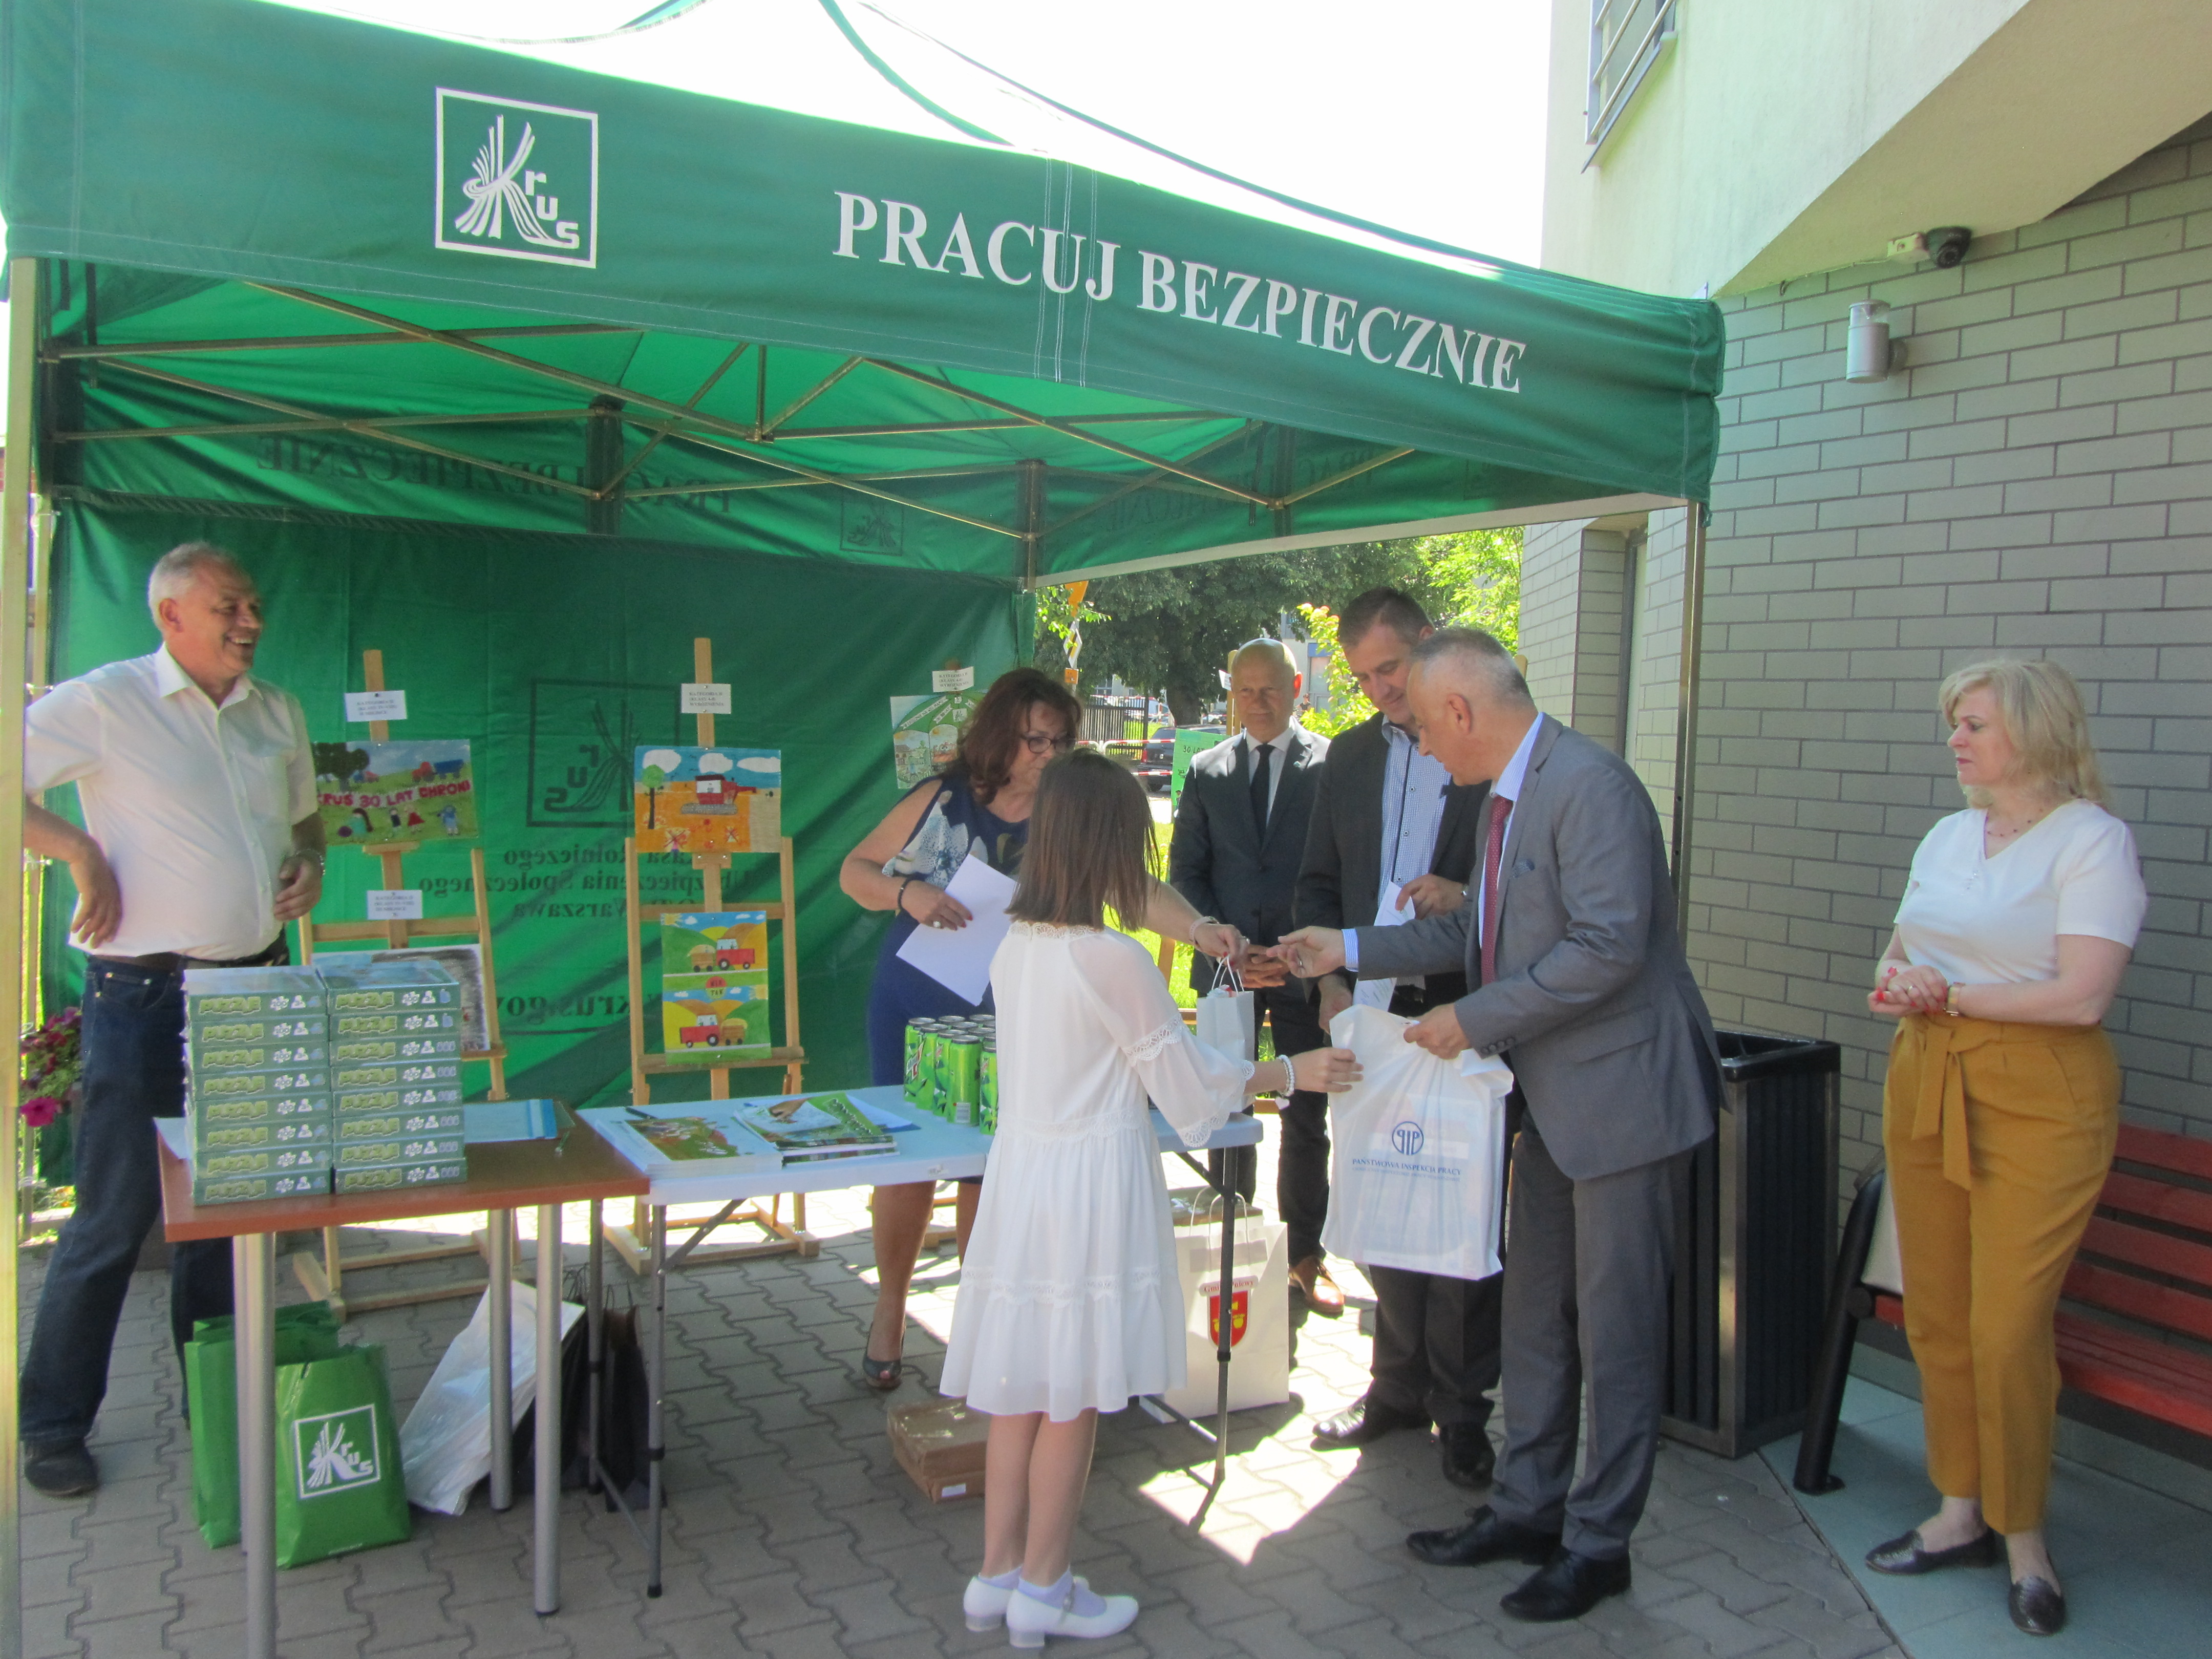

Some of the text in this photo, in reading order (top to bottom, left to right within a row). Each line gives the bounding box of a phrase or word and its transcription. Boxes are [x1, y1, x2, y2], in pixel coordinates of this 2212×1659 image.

[832, 192, 1526, 394] PRACUJ BEZPIECZNIE
[359, 795, 380, 807] 30
[386, 790, 413, 805] LAT
[418, 780, 471, 798] CHRONI
[1437, 1167, 1461, 1176] PRACY
